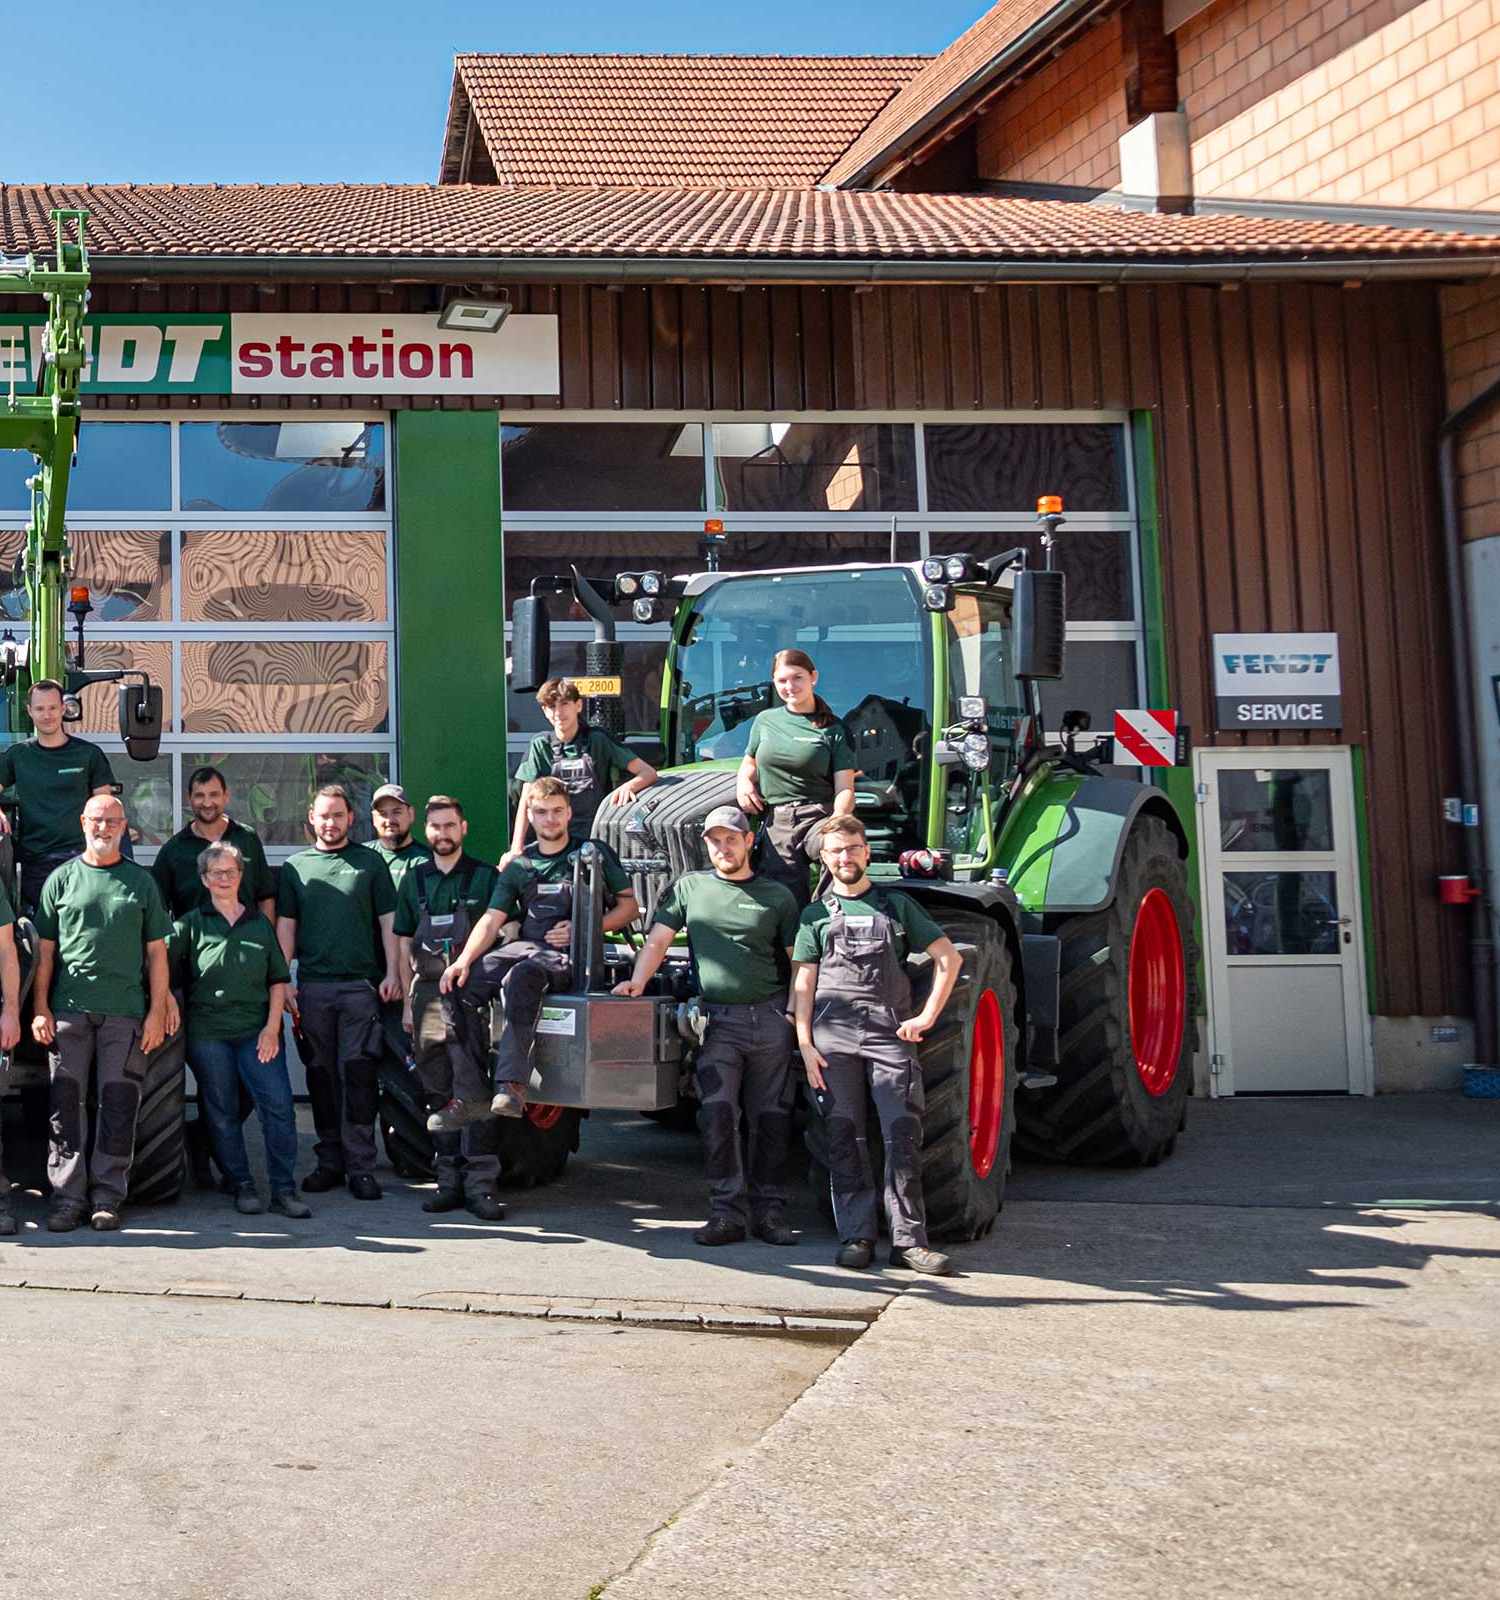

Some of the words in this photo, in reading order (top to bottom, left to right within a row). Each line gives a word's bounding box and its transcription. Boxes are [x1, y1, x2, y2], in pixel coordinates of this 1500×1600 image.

[238, 329, 474, 378] station
[1222, 654, 1333, 674] FENDT
[589, 680, 614, 692] 2800
[1237, 703, 1324, 720] SERVICE
